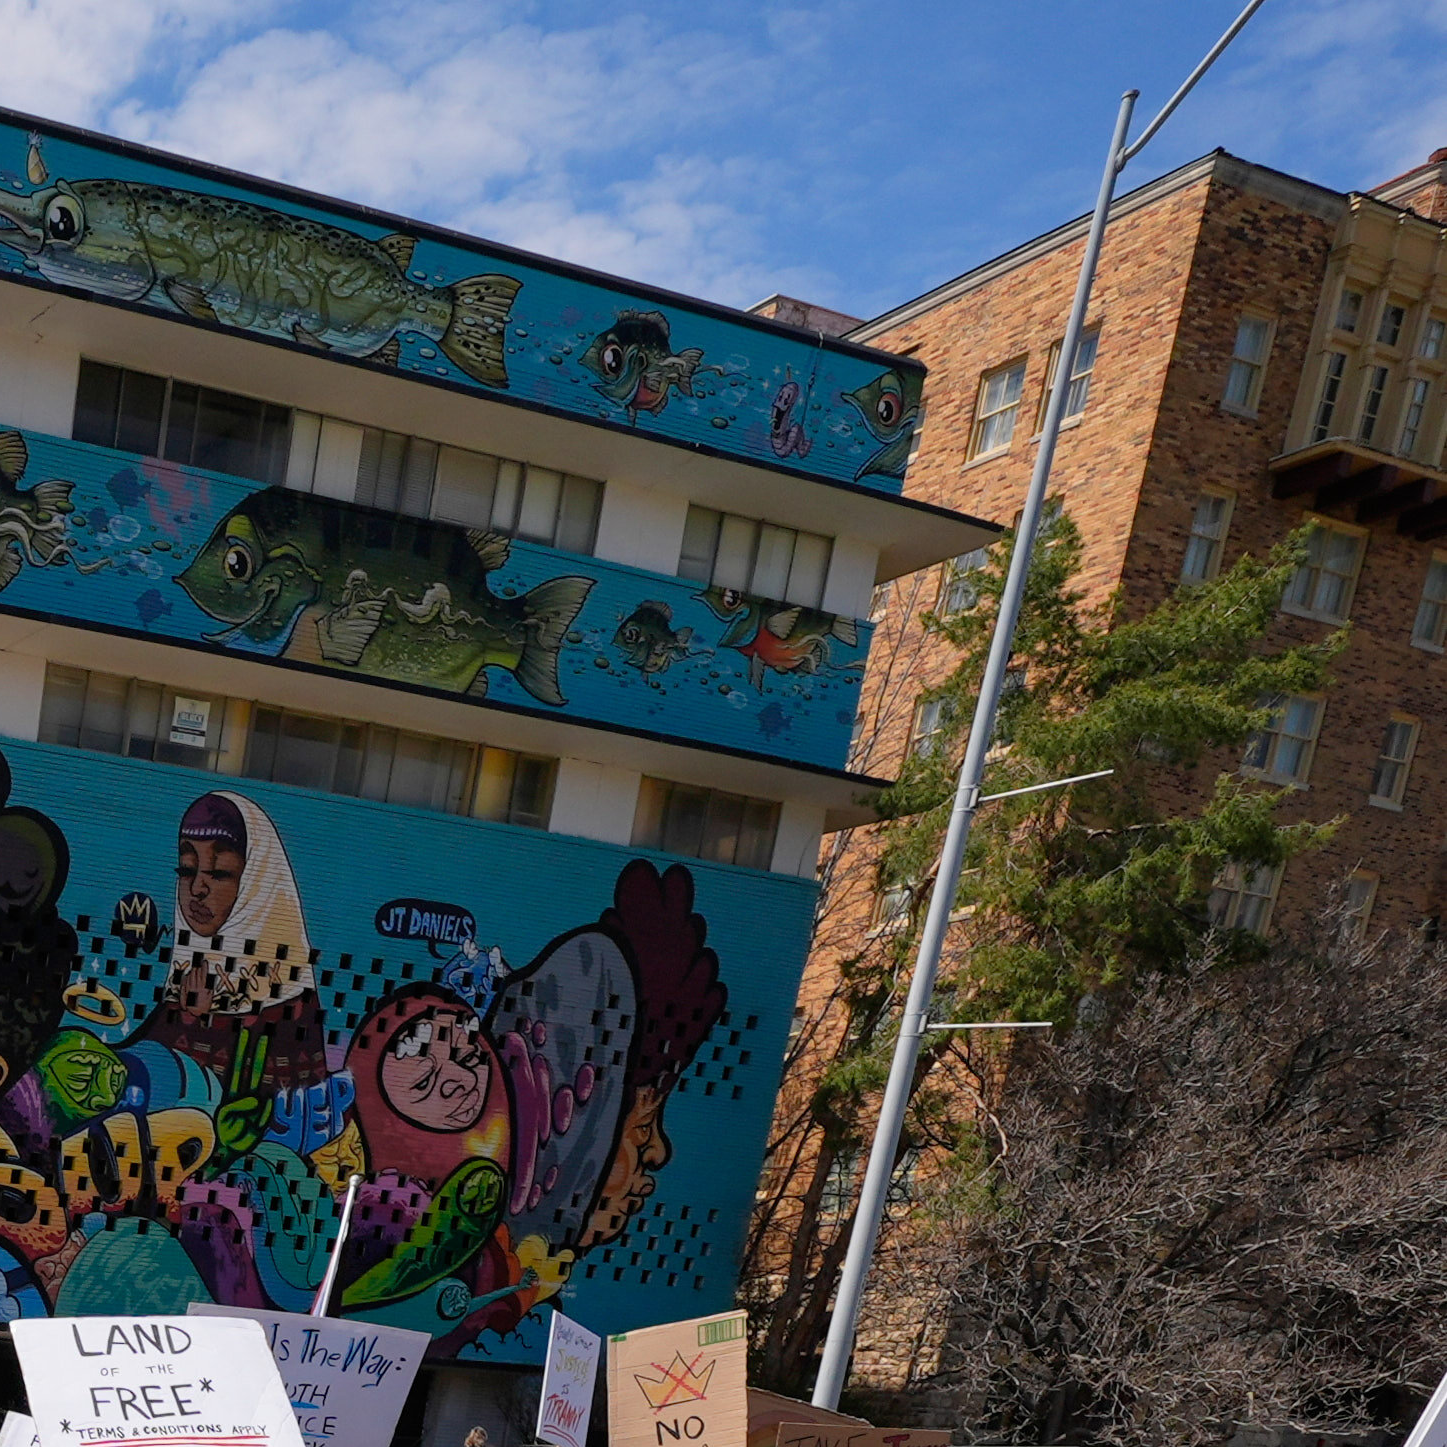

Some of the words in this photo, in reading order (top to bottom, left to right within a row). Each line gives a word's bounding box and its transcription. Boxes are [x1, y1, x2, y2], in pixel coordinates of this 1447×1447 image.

[381, 907, 406, 932] JT
[409, 908, 473, 943] DANIELS
[71, 1323, 192, 1357] LAND
[271, 1323, 290, 1361] Is
[301, 1329, 341, 1367] The
[342, 1336, 406, 1387] Way:
[100, 1367, 119, 1377] OF
[145, 1364, 175, 1375] THE
[231, 1424, 268, 1437] APPLY
[656, 1416, 705, 1446] NO
